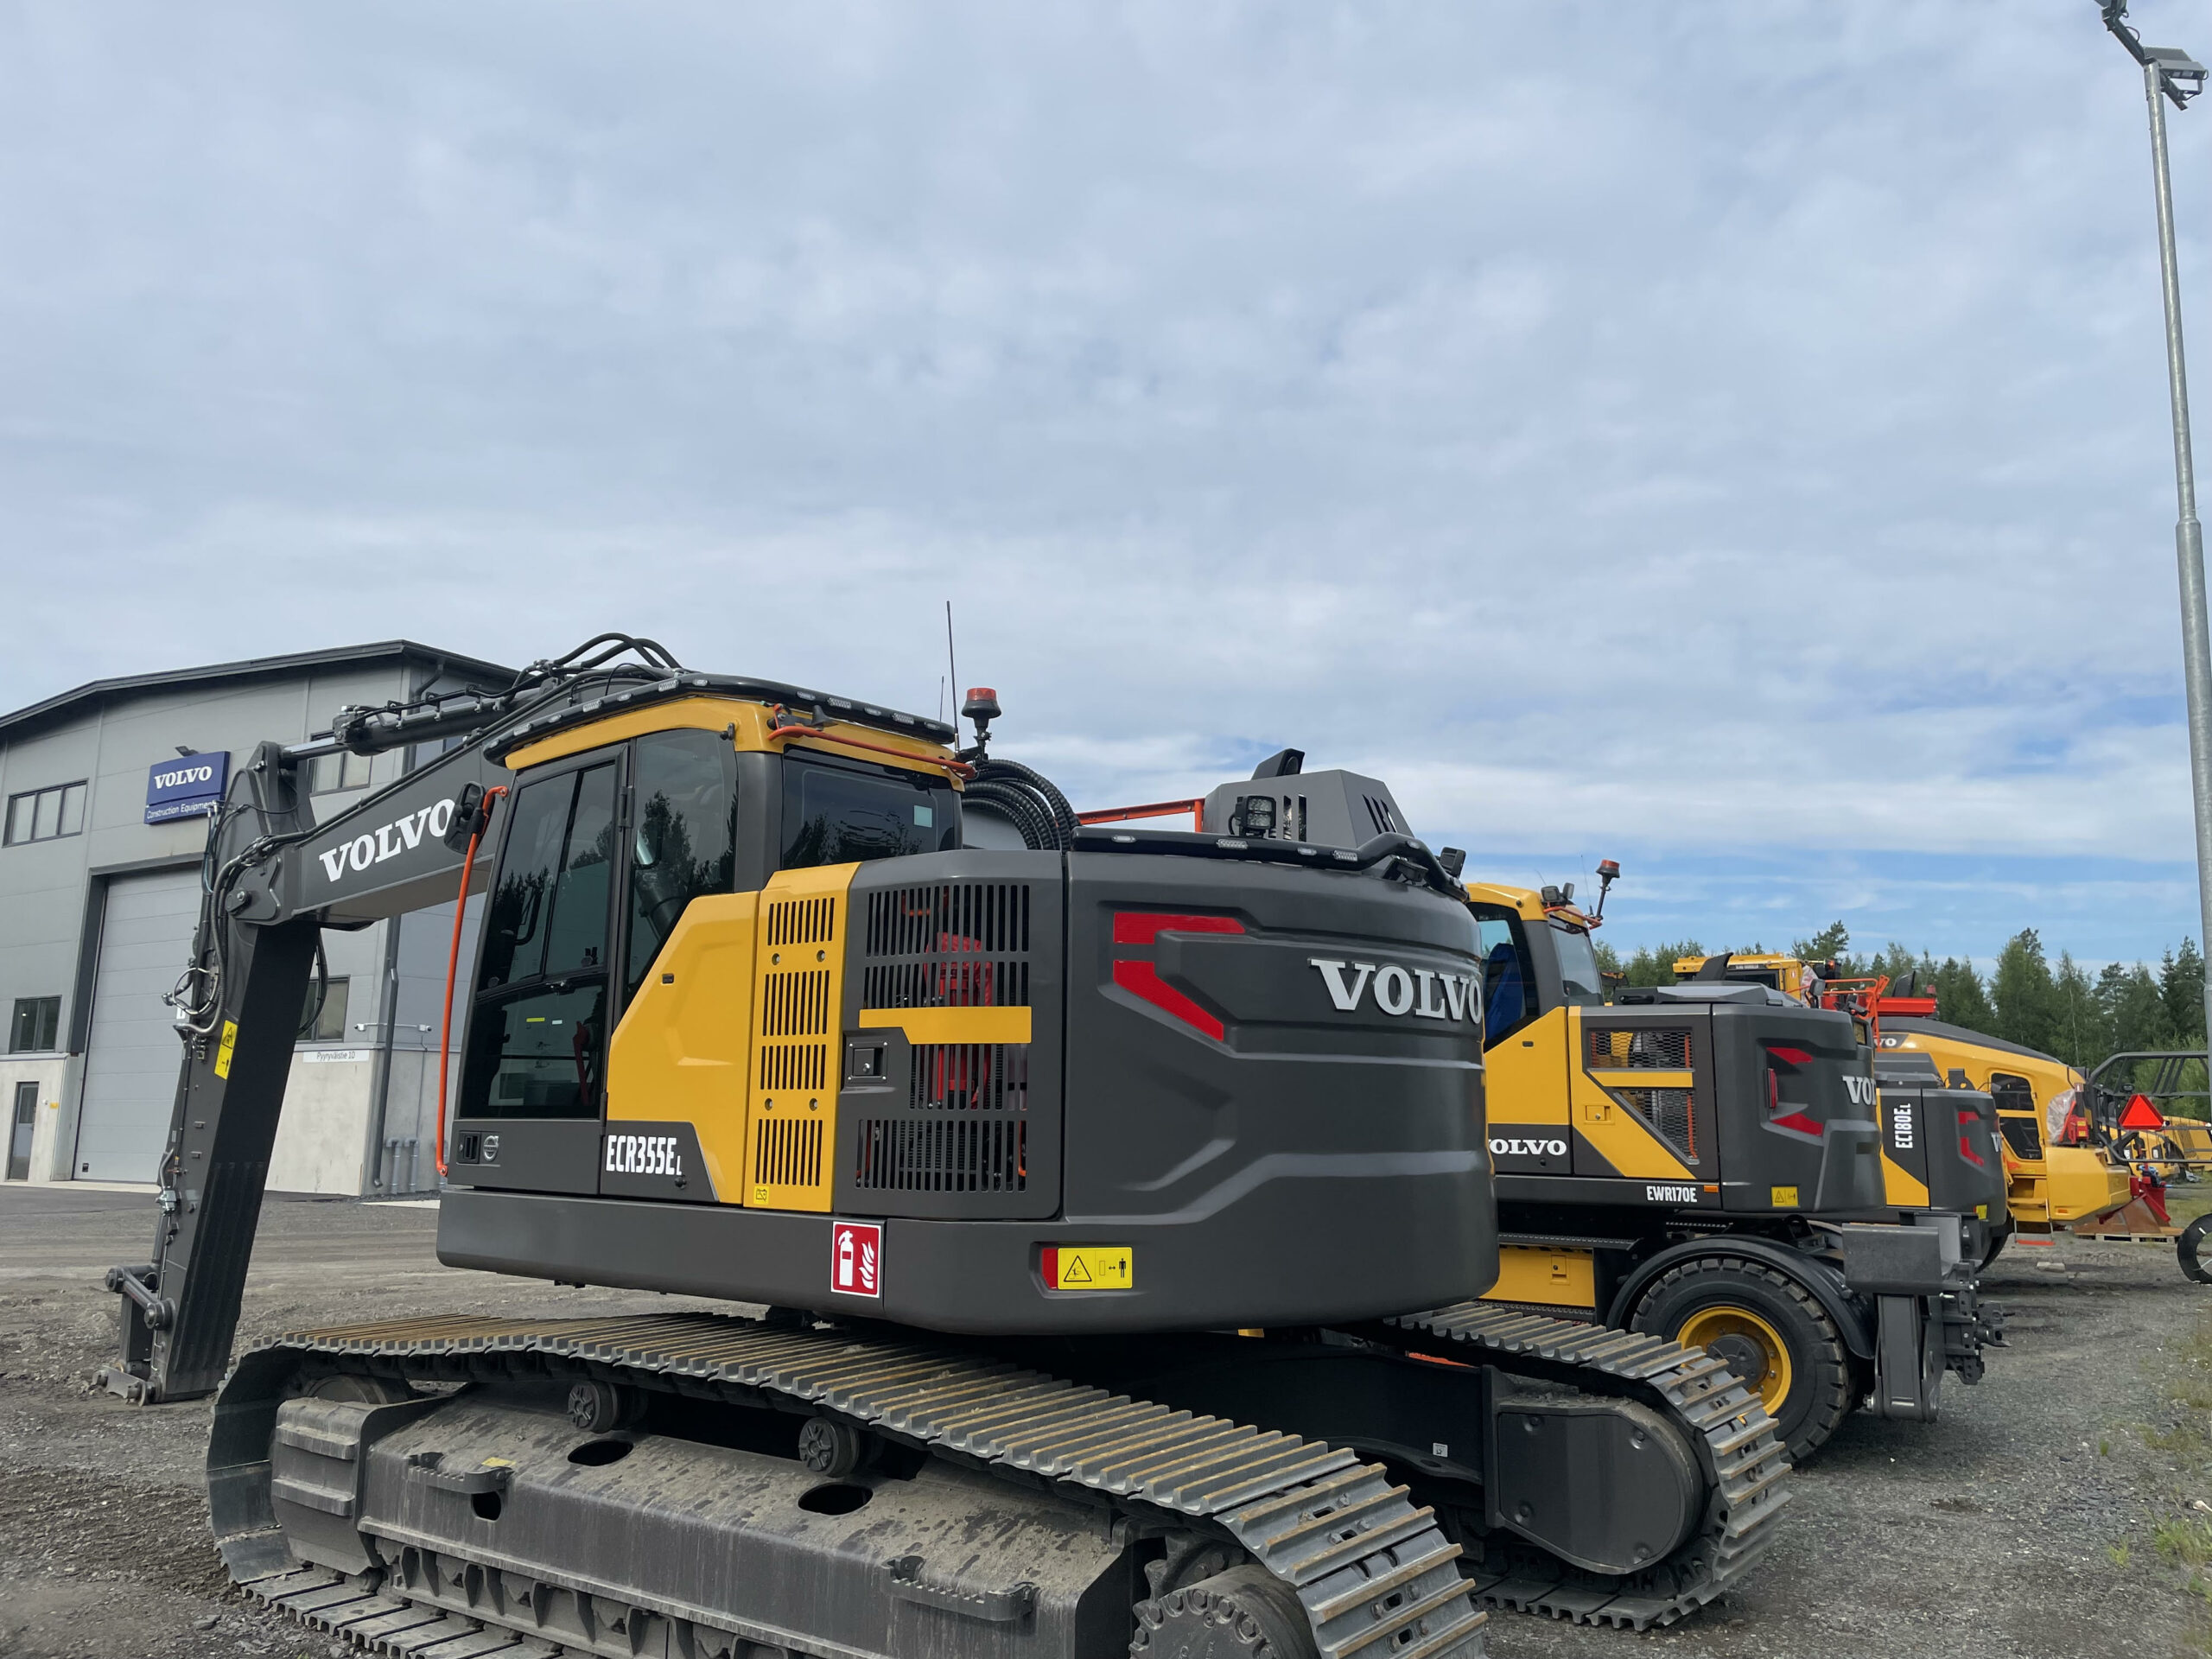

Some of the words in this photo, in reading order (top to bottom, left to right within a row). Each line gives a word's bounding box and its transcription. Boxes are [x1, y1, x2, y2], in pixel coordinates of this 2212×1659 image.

[154, 766, 213, 790] VOLVO
[146, 805, 180, 819] Construction
[319, 798, 456, 882] VOLVO
[1308, 958, 1483, 1024] VOLVO
[348, 1051, 356, 1059] 10
[1488, 1139, 1567, 1156] OLVO
[1646, 1185, 1698, 1203] EWR170E
